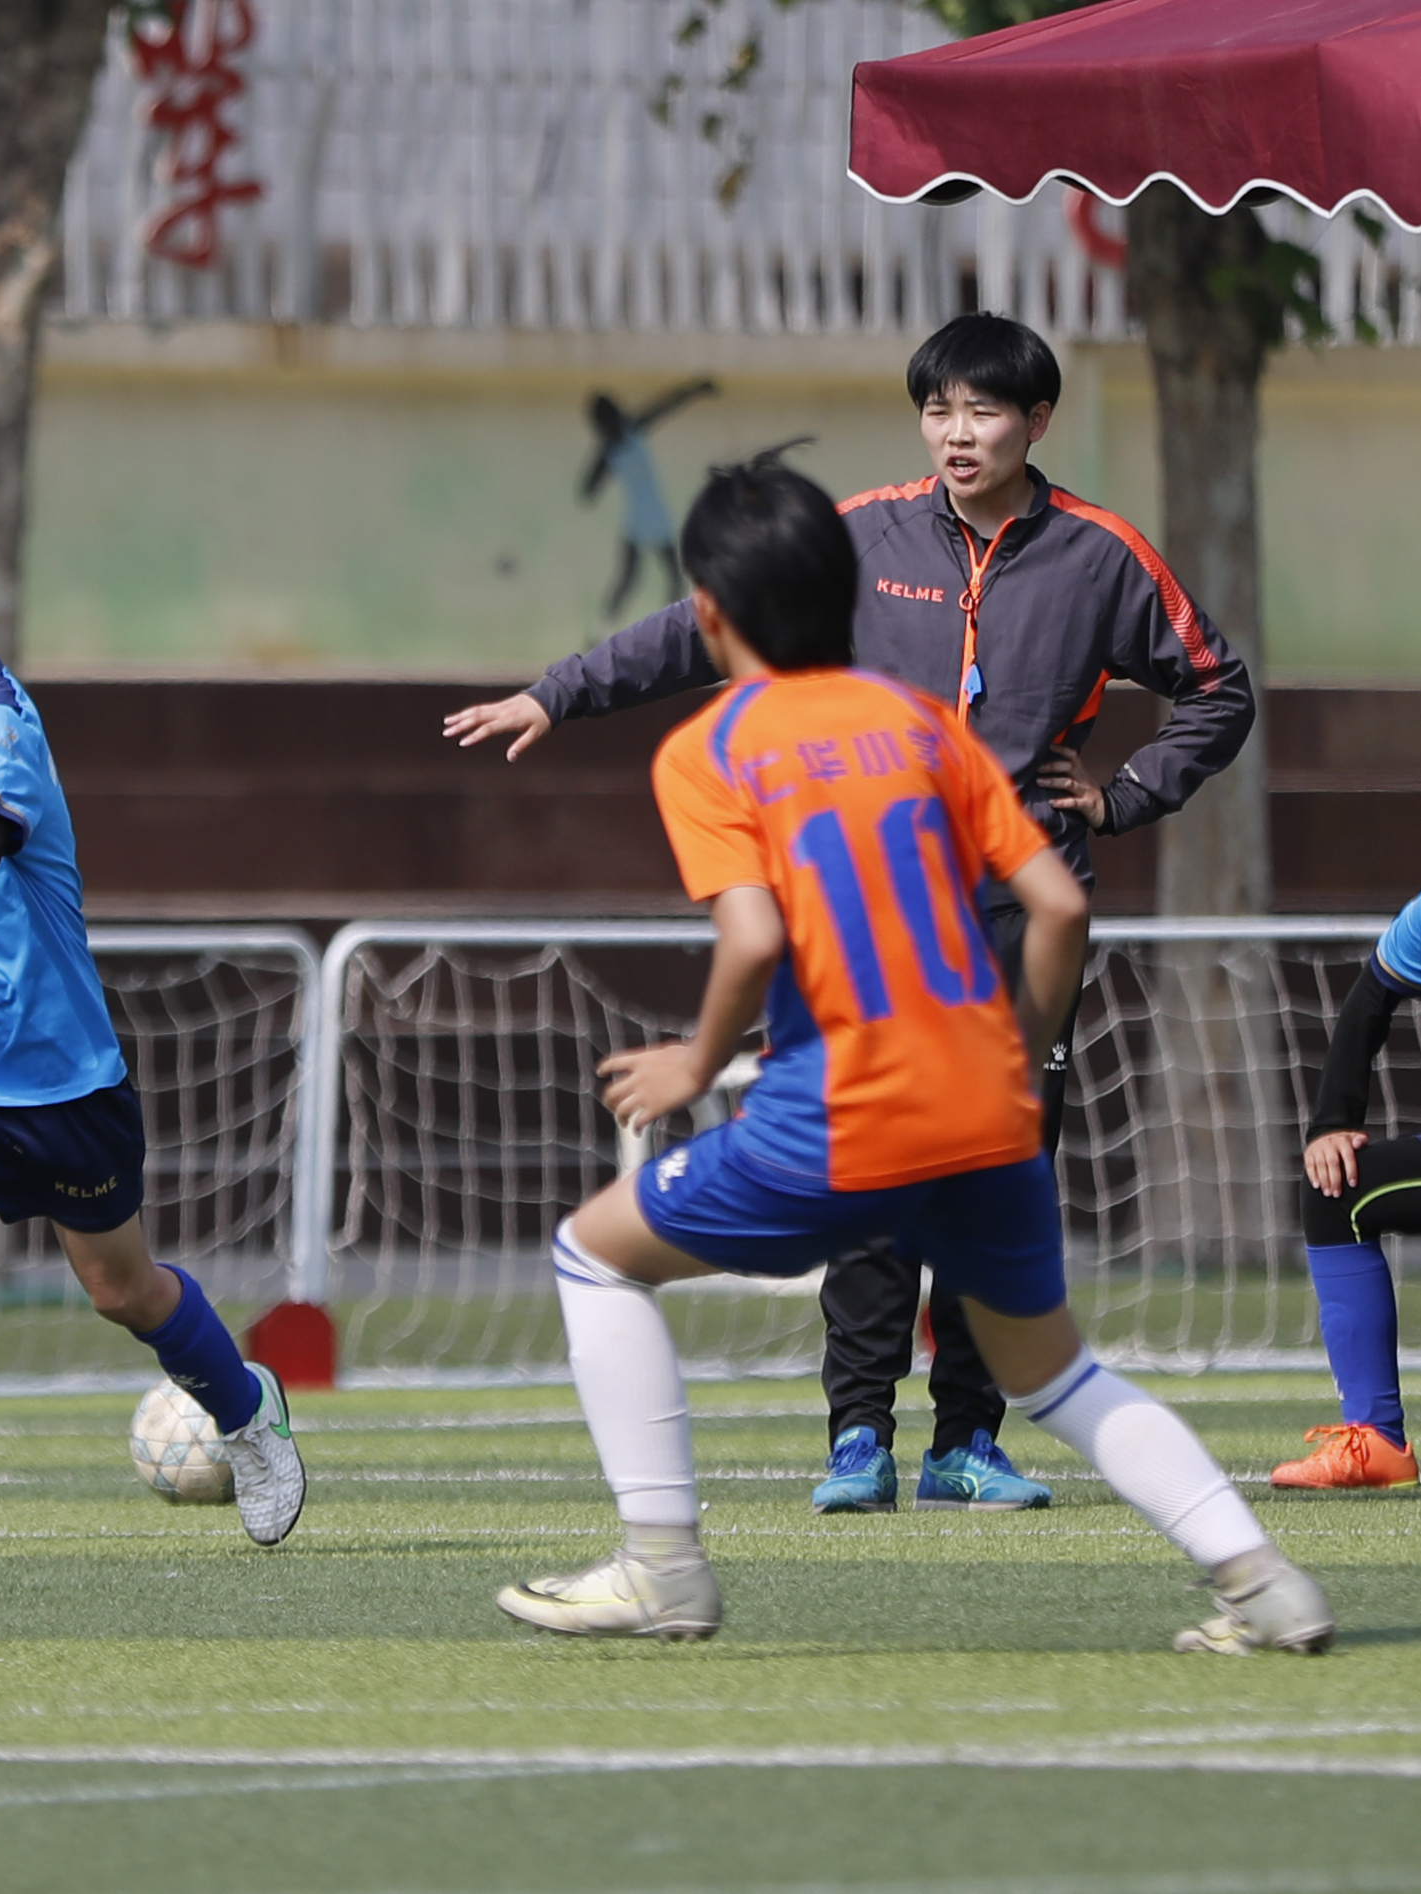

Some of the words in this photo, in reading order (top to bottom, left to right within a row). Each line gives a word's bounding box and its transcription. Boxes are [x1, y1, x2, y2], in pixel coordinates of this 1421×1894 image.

[876, 578, 945, 604] KELME
[790, 795, 999, 1024] 10
[54, 1175, 118, 1199] KELME
